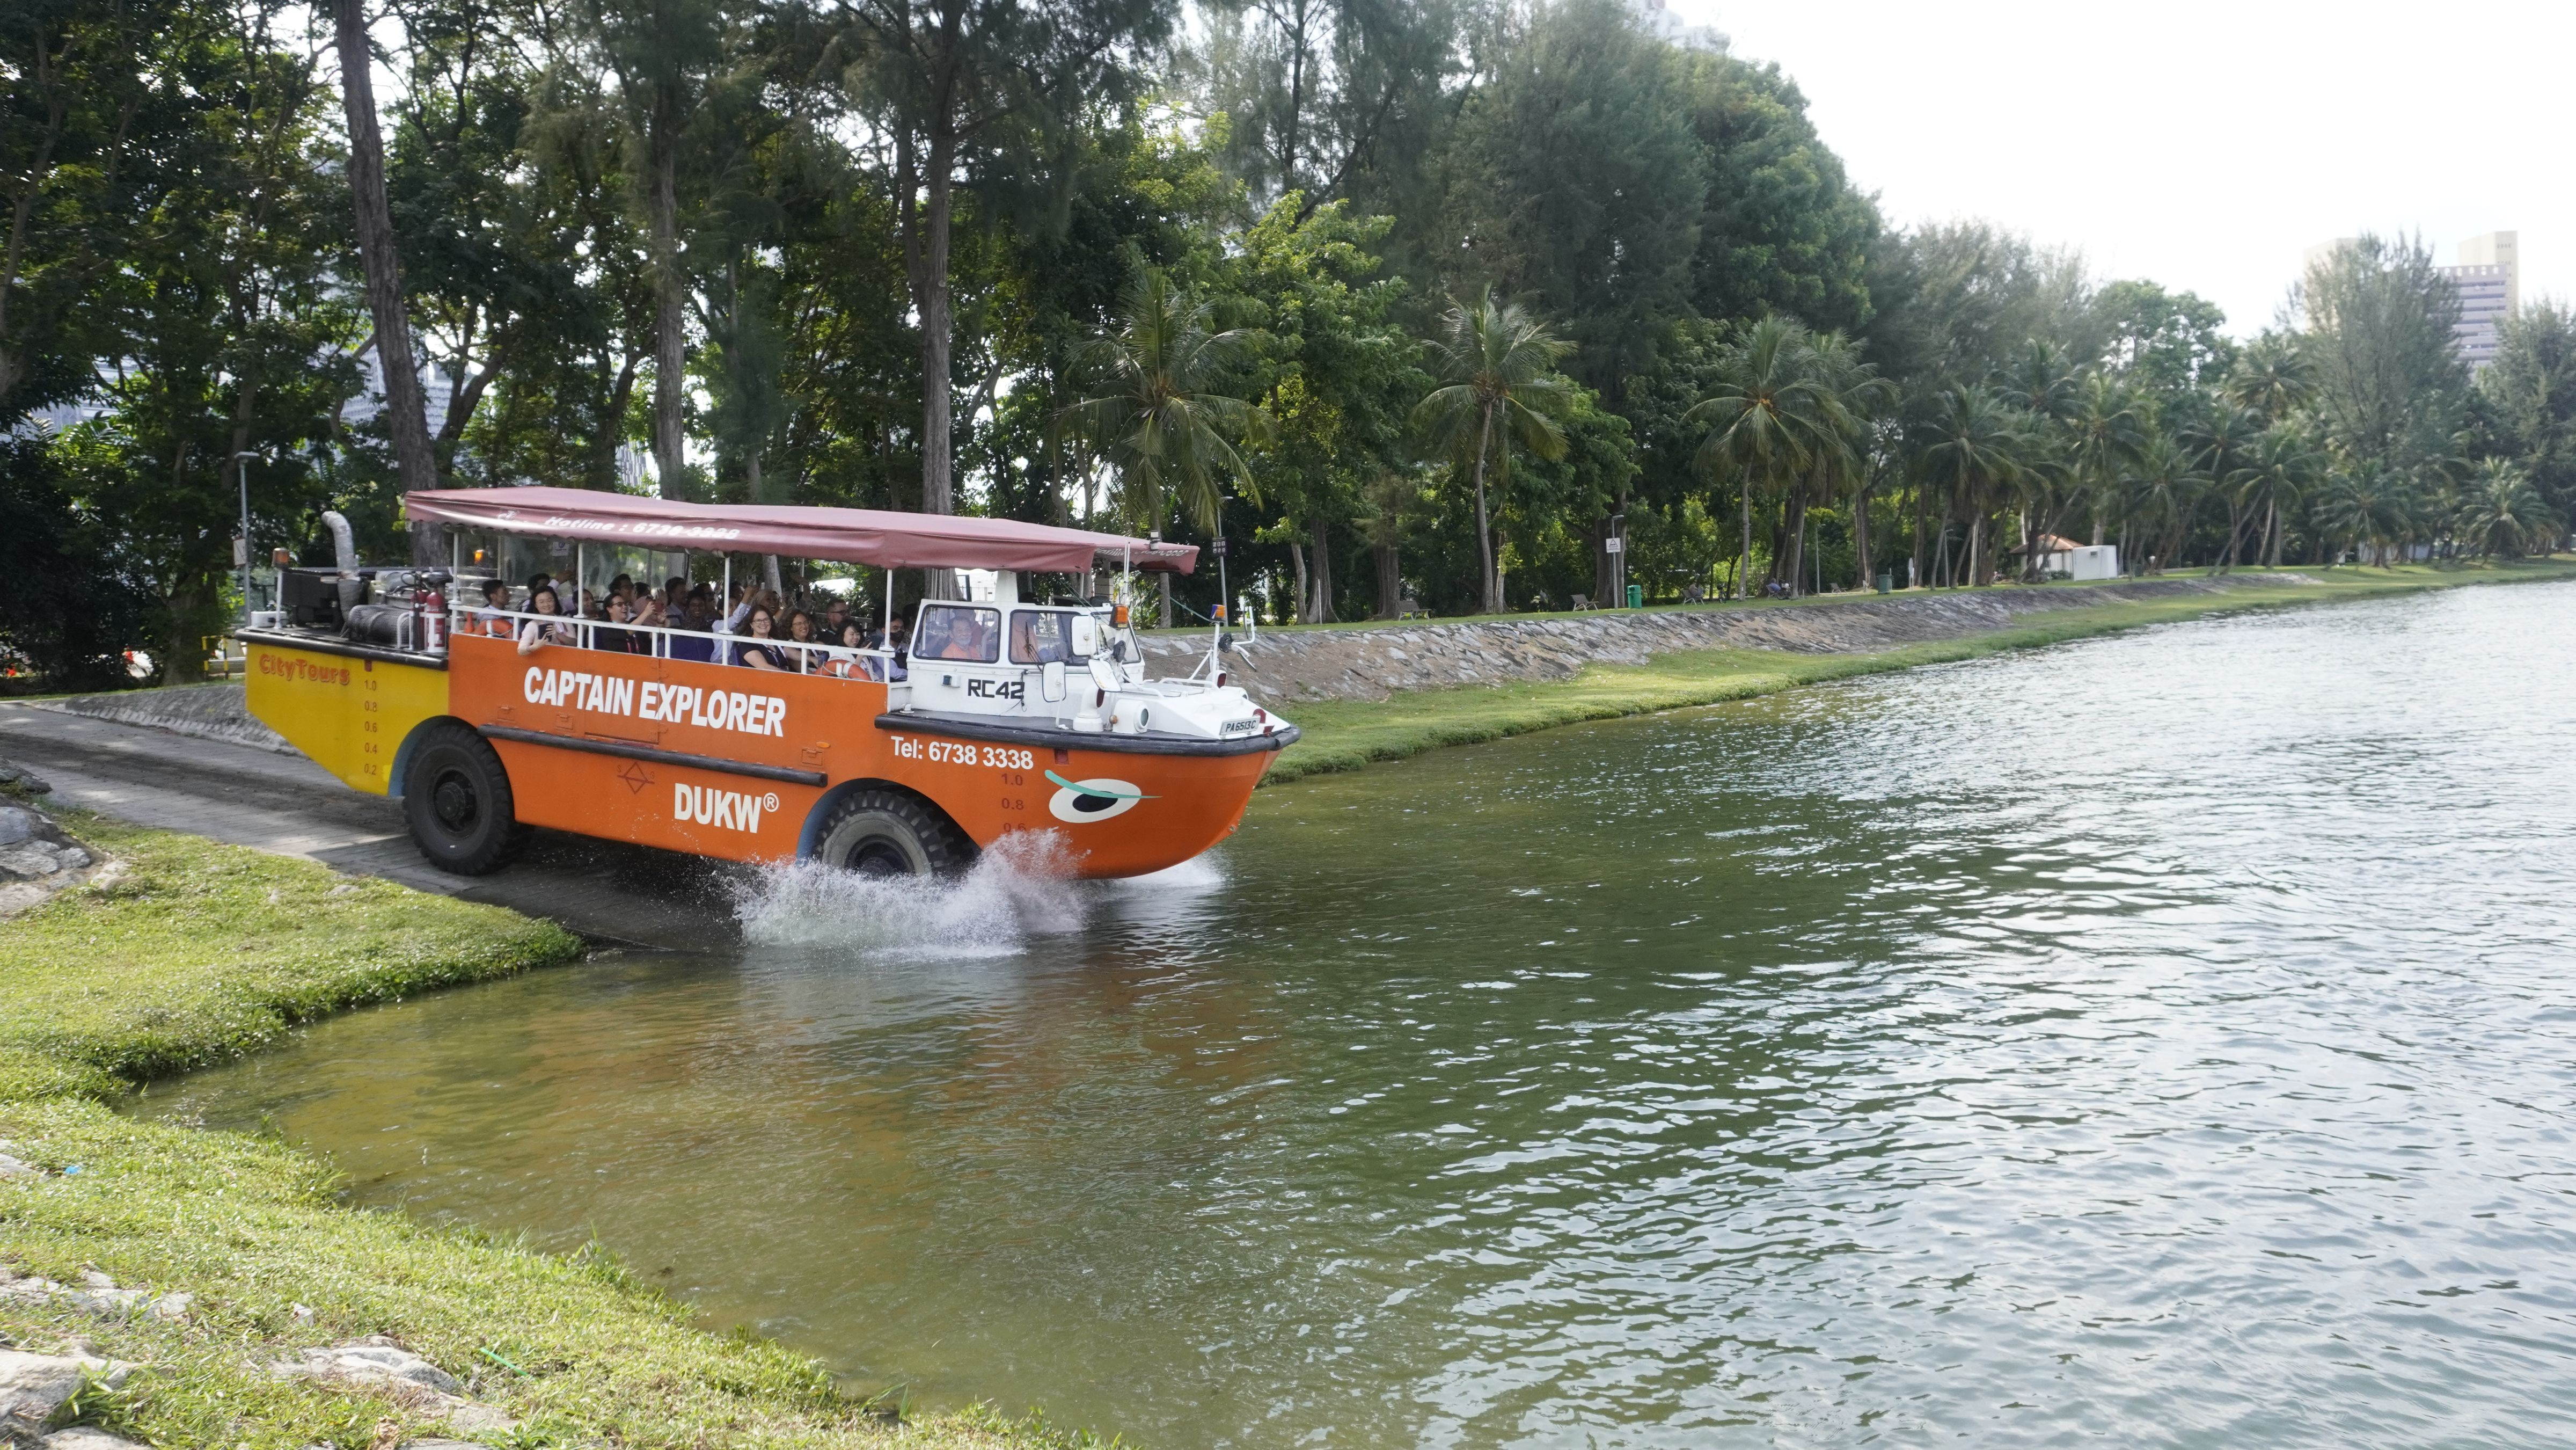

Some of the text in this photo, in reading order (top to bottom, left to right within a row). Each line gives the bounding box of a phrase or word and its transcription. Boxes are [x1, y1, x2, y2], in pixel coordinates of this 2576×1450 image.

[544, 516, 615, 530] Hotline
[364, 680, 377, 691] 1.0
[968, 679, 1024, 699] RC42
[364, 701, 377, 712] 0.8
[524, 667, 786, 737] CAPTAIN EXPLORER
[364, 721, 377, 732] 0.6
[364, 742, 377, 754] 0.4
[891, 736, 1034, 769] Tel: 6738 3338
[364, 763, 377, 775] 0.2
[1001, 773, 1023, 786] 1.0
[1001, 798, 1024, 811] 0.8
